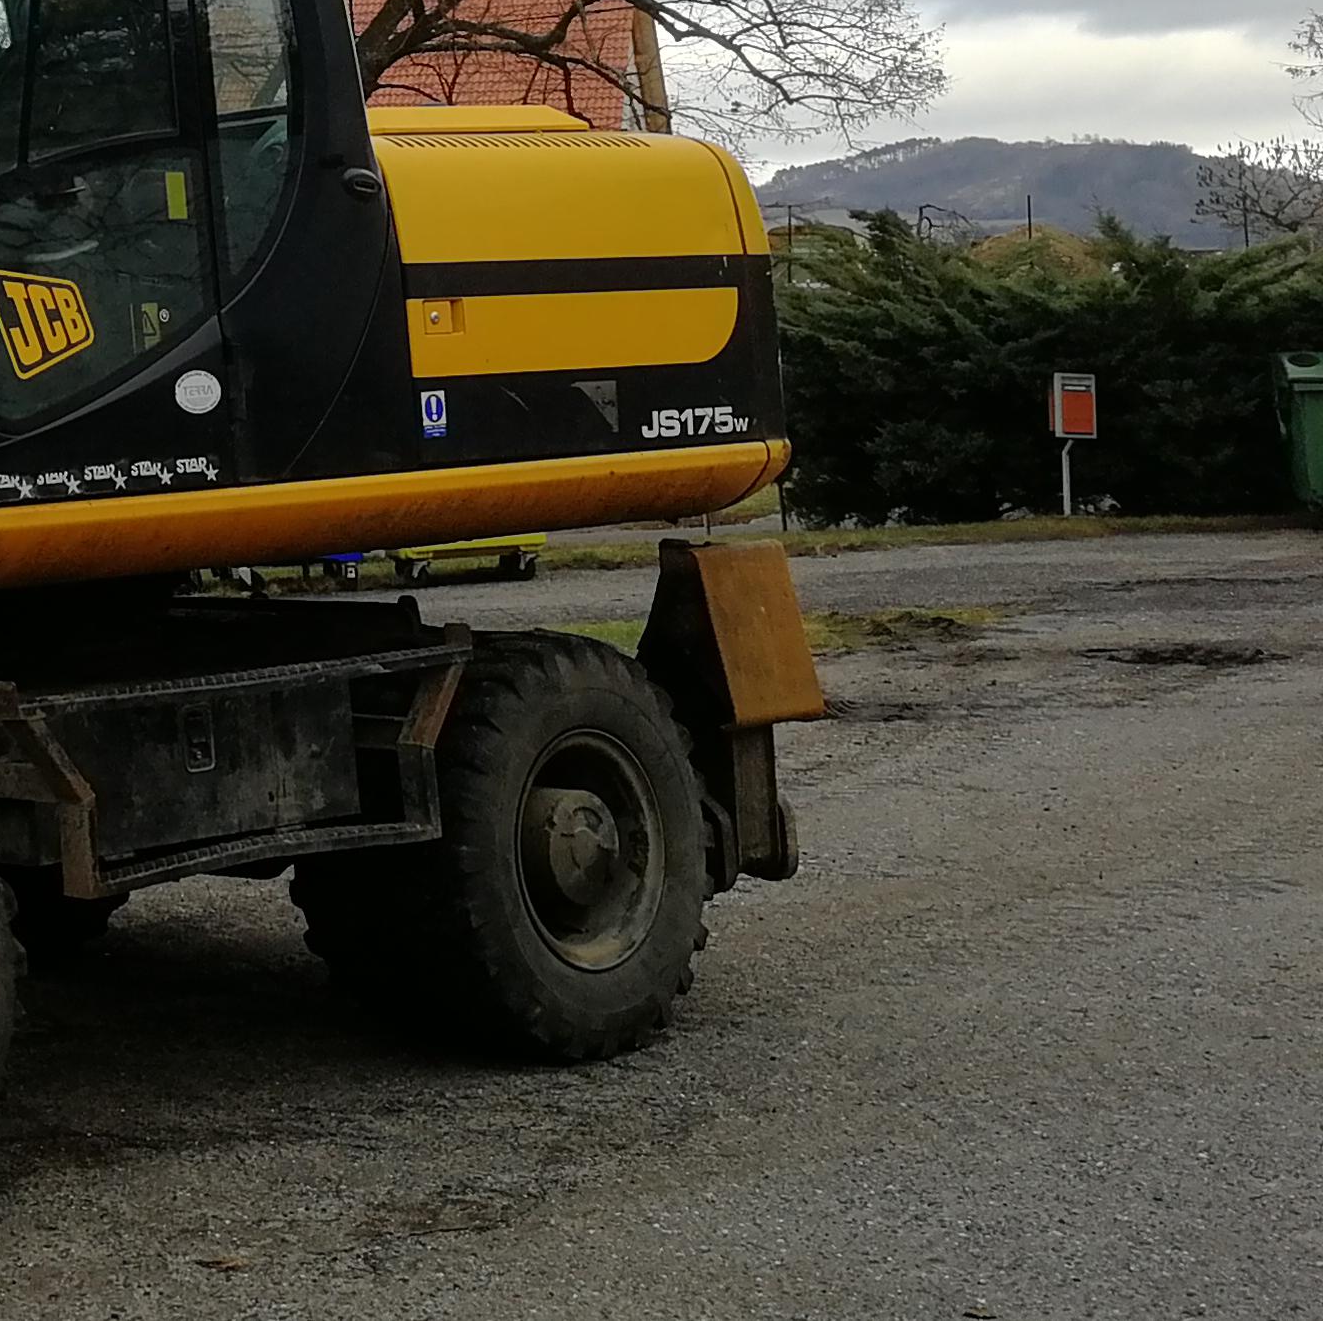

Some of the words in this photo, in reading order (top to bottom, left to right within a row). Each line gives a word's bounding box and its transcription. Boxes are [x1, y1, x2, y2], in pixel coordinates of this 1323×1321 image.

[2, 280, 87, 366] JCB
[84, 463, 121, 482] STAR
[176, 457, 212, 476] STAR
